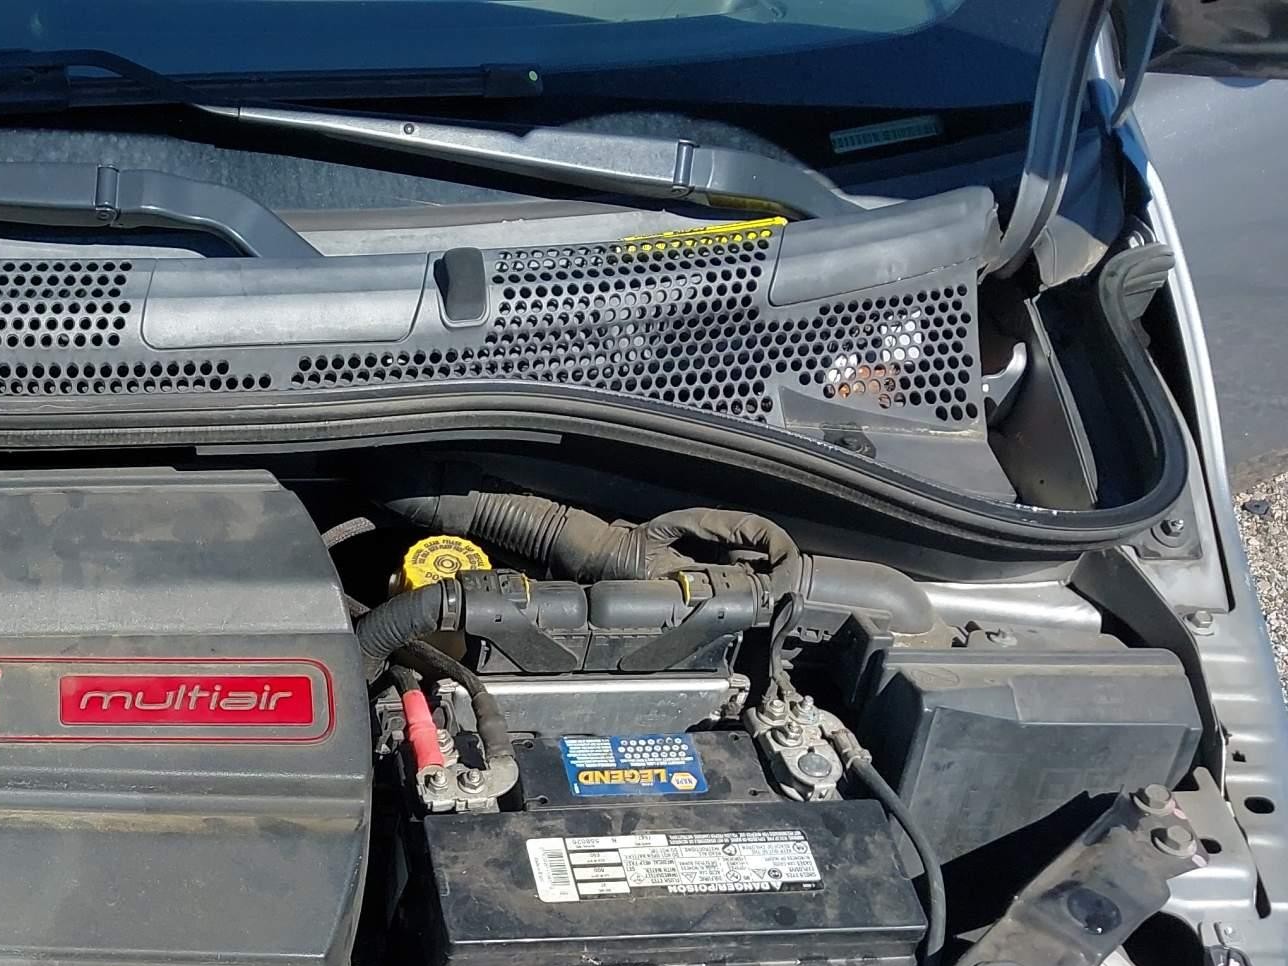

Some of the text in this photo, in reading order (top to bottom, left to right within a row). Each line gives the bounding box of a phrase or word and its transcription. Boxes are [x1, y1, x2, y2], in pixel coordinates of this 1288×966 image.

[79, 684, 293, 711] multiair
[578, 769, 668, 785] LEGEND
[668, 882, 770, 892] DANGER/POISON
